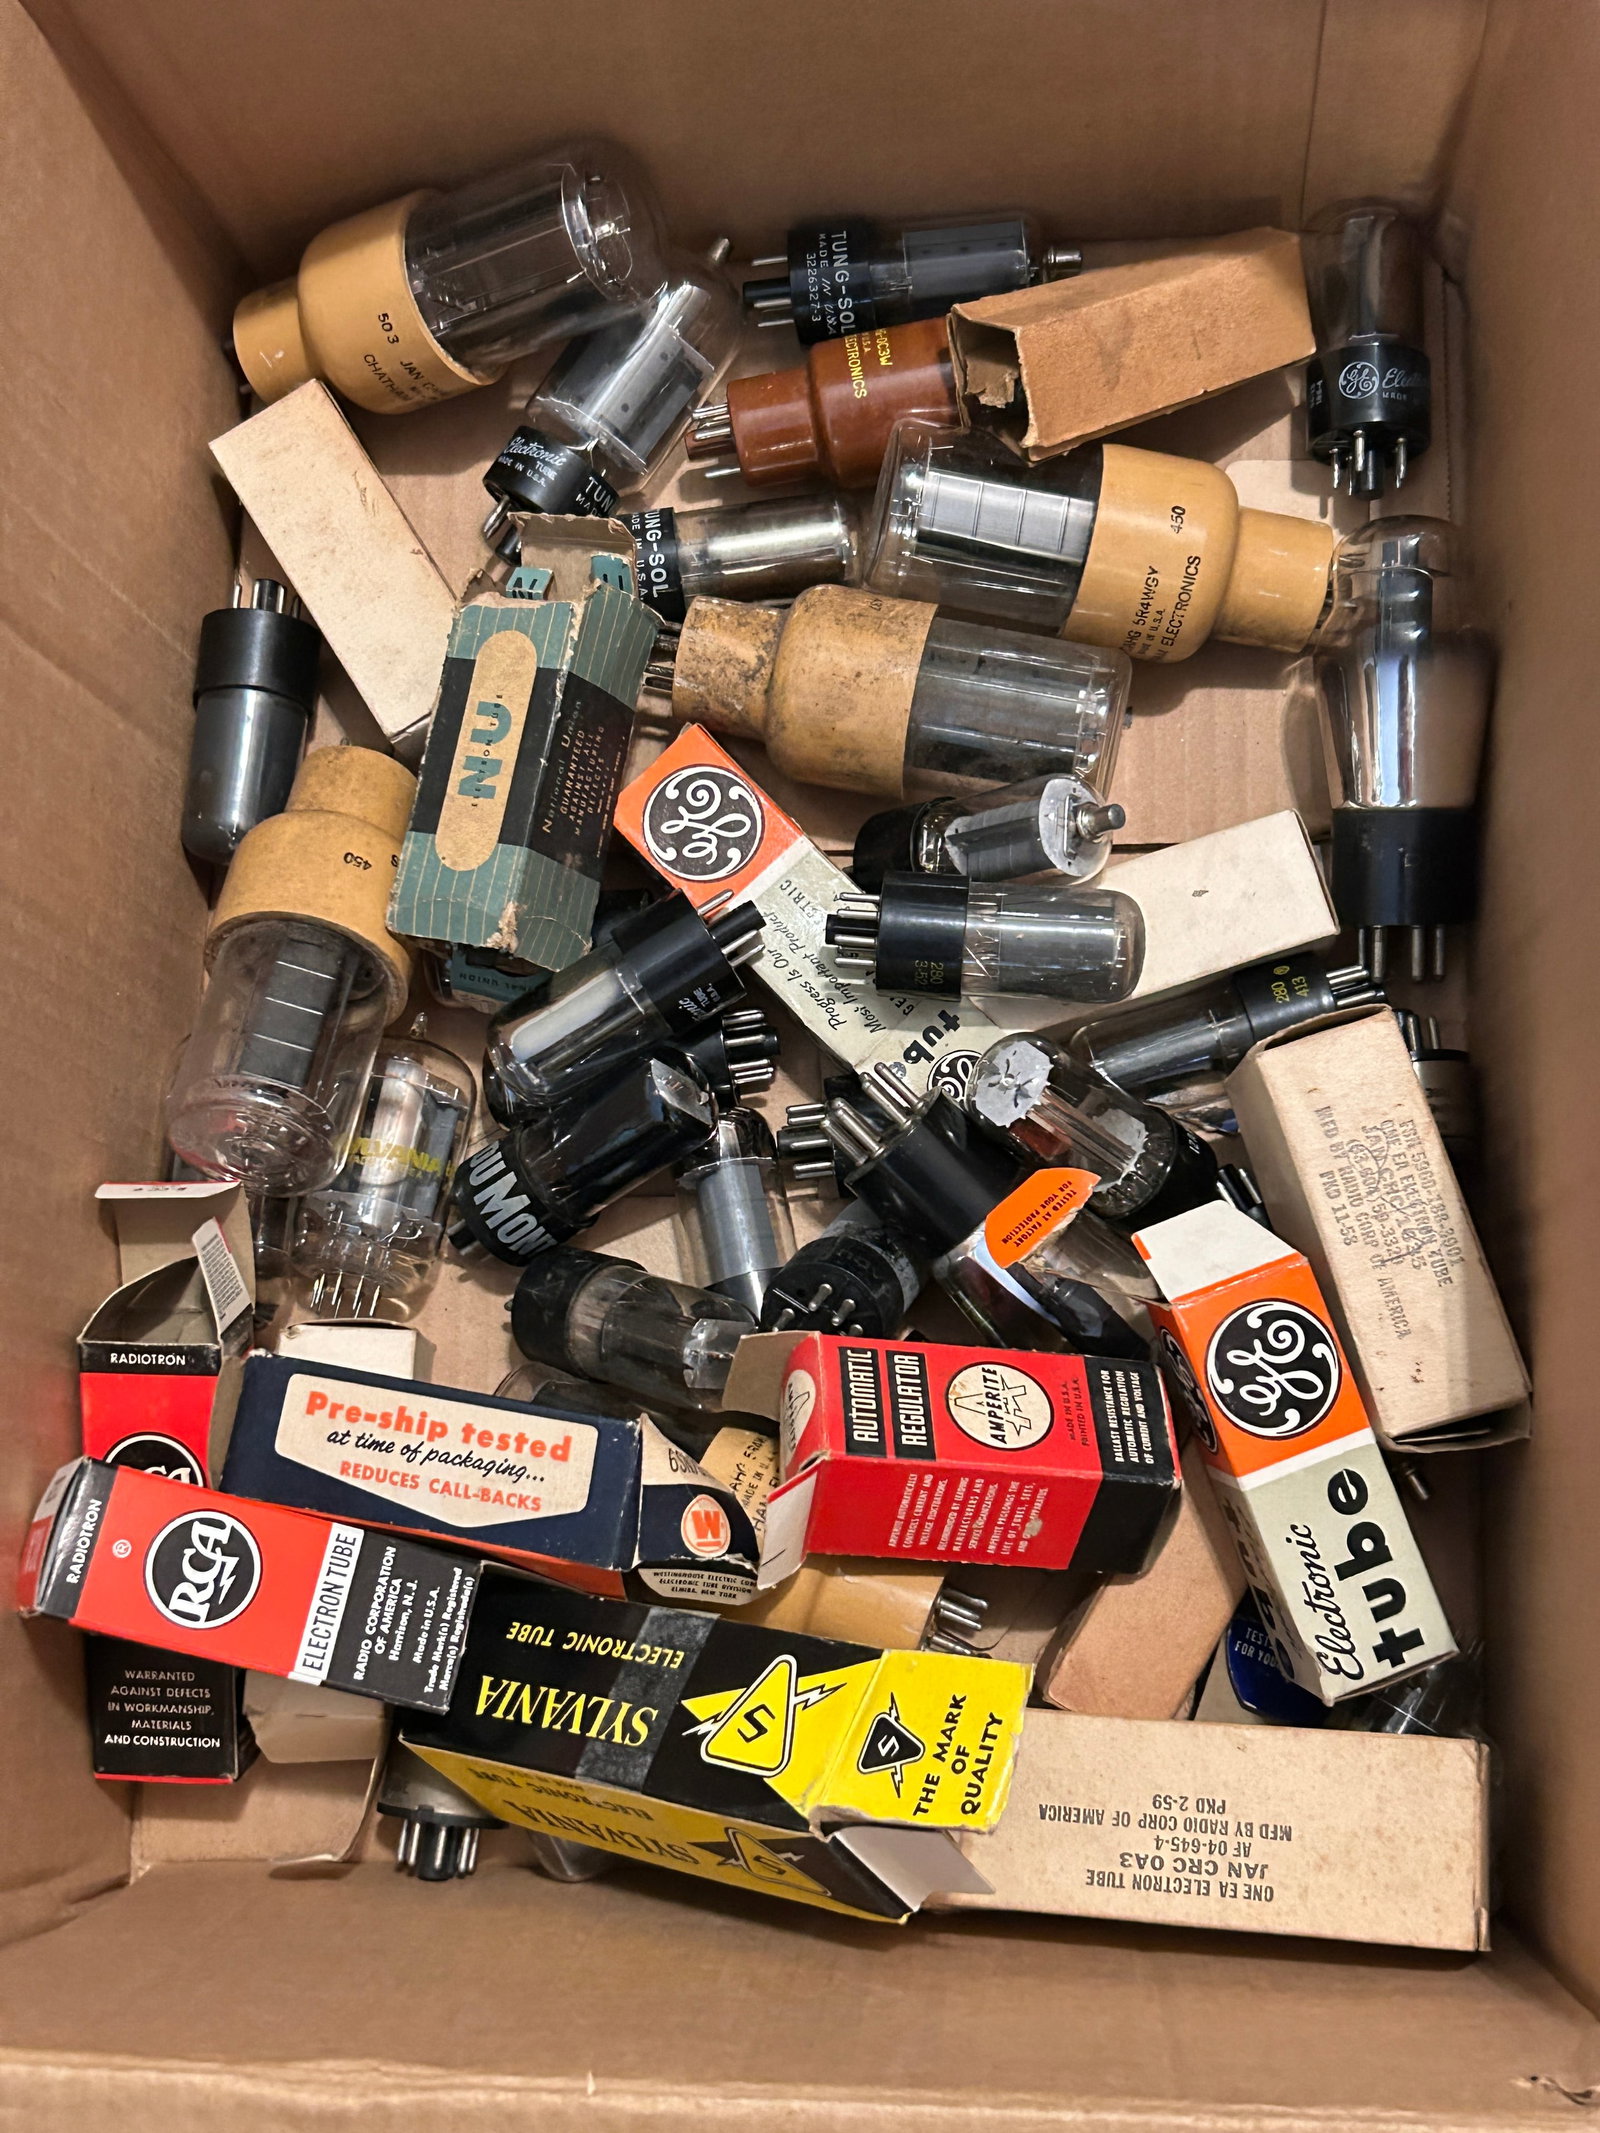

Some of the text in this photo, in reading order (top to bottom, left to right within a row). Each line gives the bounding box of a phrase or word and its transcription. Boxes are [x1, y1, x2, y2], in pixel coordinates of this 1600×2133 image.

[818, 234, 829, 267] MADE
[831, 231, 855, 334] TUNG-SOL
[504, 436, 568, 467] Electronic
[1161, 555, 1201, 647] ELECTRONICS
[560, 730, 585, 815] GUARANTEED
[767, 949, 847, 1030] Progress Is Our
[802, 953, 859, 1005] Important
[930, 961, 944, 984] 280
[1271, 982, 1290, 1003] 280
[1040, 1193, 1059, 1210] YOUR
[1001, 1209, 1040, 1245] PROTECTION
[1428, 1247, 1454, 1288] TUBE
[110, 1353, 186, 1366] RADIOTRON
[847, 1349, 879, 1442] AUTOMATIC
[893, 1354, 928, 1446] REGULATOR
[981, 1366, 1008, 1444] AMPERITE
[1100, 1369, 1125, 1463] BALLAST RESISTANCE FOR
[1115, 1370, 1140, 1463] AUTOMATIC REGULATION
[1130, 1371, 1154, 1465] OF CURRENT AND VOLTAGE
[306, 1390, 573, 1463] Pre-ship tested
[327, 1431, 350, 1444] at
[354, 1432, 395, 1455] time
[400, 1441, 423, 1463] of
[339, 1461, 543, 1513] REDUCES CALL-BACKS
[66, 1499, 103, 1584] RADIOTRON
[691, 1510, 721, 1539] W
[169, 1518, 236, 1624] RCA
[1327, 1467, 1425, 1669] tube
[302, 1533, 357, 1671] ELECTRON TUBE
[353, 1546, 397, 1680] RADIO CORPORATION
[374, 1578, 403, 1655] OF AMERICA
[1285, 1523, 1365, 1681] Electronic
[388, 1600, 412, 1662] Harrison,
[412, 1631, 427, 1664] Made
[423, 1618, 432, 1630] in
[505, 1621, 685, 1669] ELECTRONIC TUBE
[1235, 1641, 1255, 1658] FOR
[111, 1686, 210, 1698] AGAINST DEFECTS
[125, 1670, 195, 1681] WARRANTED
[107, 1702, 120, 1712] IN
[131, 1719, 192, 1730] MATERIALS
[475, 1674, 659, 1747] SYLVANIA
[105, 1734, 220, 1748] AND CONSTRUCTION
[912, 1693, 968, 1817] THE MARK
[950, 1743, 971, 1775] OF
[960, 1711, 1004, 1816] QUALITY
[1038, 1803, 1293, 1842] MFD BY RADIO CORP OF AMERICA
[1152, 1794, 1227, 1815] PKD 2-59
[501, 1798, 700, 1866] SYLVANIA
[1232, 1841, 1252, 1858] AF
[1085, 1869, 1275, 1902] ONE EA ELECTRON TUBE
[1172, 1857, 1220, 1876] CRC
[1227, 1861, 1269, 1880] JAN
